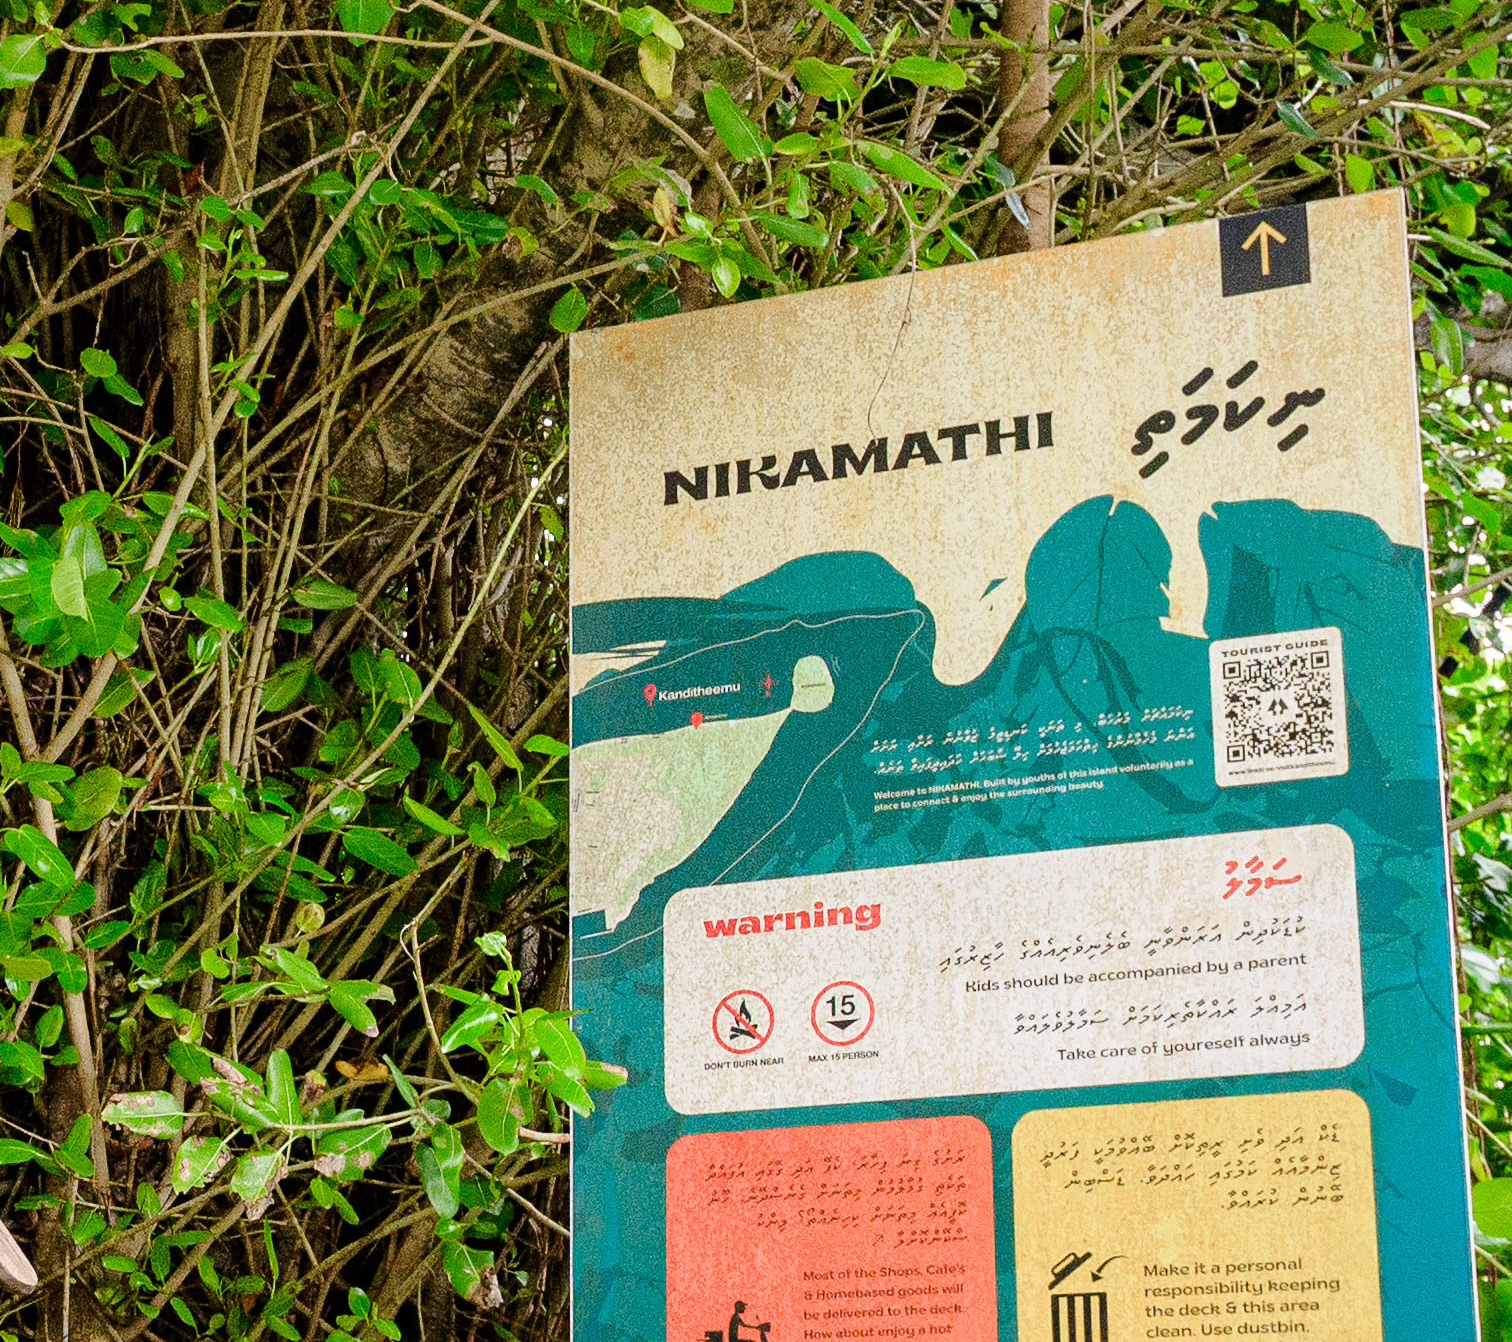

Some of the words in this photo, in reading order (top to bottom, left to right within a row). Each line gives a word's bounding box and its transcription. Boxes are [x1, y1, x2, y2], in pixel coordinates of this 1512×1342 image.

[1131, 360, 1326, 479] ނިކަމަތި
[663, 411, 1054, 505] NIKAMATHI
[1221, 644, 1282, 658] TOURIST
[1285, 639, 1329, 650] GUIDE
[658, 682, 741, 702] Kanditheemu
[873, 789, 915, 800] Welcome
[916, 787, 927, 796] to
[983, 778, 1006, 789] Built
[1008, 776, 1021, 786] by
[1021, 772, 1056, 785] youths
[1057, 770, 1067, 780] of
[1069, 769, 1087, 779] this
[1088, 765, 1118, 777] island
[874, 801, 899, 813] place
[900, 799, 911, 809] to
[912, 796, 951, 808] connect
[951, 795, 959, 804] &
[960, 792, 988, 804] enjoy
[989, 790, 1005, 800] the
[1007, 784, 1067, 798] surrounding
[1223, 855, 1303, 899] ސަމާލު
[703, 901, 882, 938] warning
[1235, 915, 1307, 944] ކުޑަކުދިން
[1143, 923, 1222, 958] އަރަންވާނީ
[965, 977, 1000, 994] Kids
[1003, 971, 1059, 990] should
[1063, 971, 1085, 985] be
[1088, 961, 1202, 983] accompanied
[1206, 959, 1230, 975] by
[1233, 959, 1244, 970] a
[1247, 953, 1307, 973] parent
[826, 994, 856, 1017] 15
[1249, 993, 1308, 1020] އަމިއްލަ
[808, 1054, 827, 1063] MAX
[831, 1052, 840, 1061] 15
[842, 1050, 879, 1060] PERSON
[1057, 1046, 1097, 1062] Take
[1099, 1045, 1138, 1059] care
[1141, 1040, 1159, 1055] of
[1161, 1035, 1246, 1057] youreself
[1248, 1031, 1311, 1050] always
[704, 1061, 731, 1071] DON'T
[733, 1059, 758, 1069] BURN
[759, 1057, 784, 1067] NEAR
[1238, 1127, 1264, 1154] ވެށި
[1275, 1126, 1304, 1152] އަދި
[1317, 1123, 1341, 1143] ޑެކް
[803, 1270, 834, 1281] Most
[837, 1268, 851, 1279] of
[854, 1267, 877, 1278] the
[1143, 1263, 1190, 1277] Make
[1194, 1261, 1207, 1275] it
[1210, 1264, 1221, 1274] a
[1225, 1257, 1303, 1276] personal
[804, 1291, 813, 1301] &
[816, 1286, 895, 1300] Homebased
[897, 1284, 939, 1298] goods
[942, 1283, 964, 1294] will
[1144, 1280, 1263, 1299] responsibility
[1268, 1277, 1341, 1294] keeping
[803, 1310, 820, 1321] be
[823, 1307, 884, 1319] delivered
[887, 1306, 901, 1317] to
[904, 1304, 926, 1316] the
[1145, 1305, 1174, 1318] the
[1178, 1302, 1221, 1317] deck
[1225, 1301, 1237, 1314] &
[1241, 1300, 1275, 1313] this
[1279, 1300, 1320, 1312] area
[803, 1329, 832, 1340] How
[835, 1327, 874, 1338] about
[877, 1325, 915, 1339] enjoy
[918, 1327, 926, 1335] a
[929, 1323, 953, 1335] hot
[1146, 1325, 1197, 1339] clean.
[1200, 1323, 1233, 1337] Use
[1237, 1319, 1310, 1335] dustbin.
